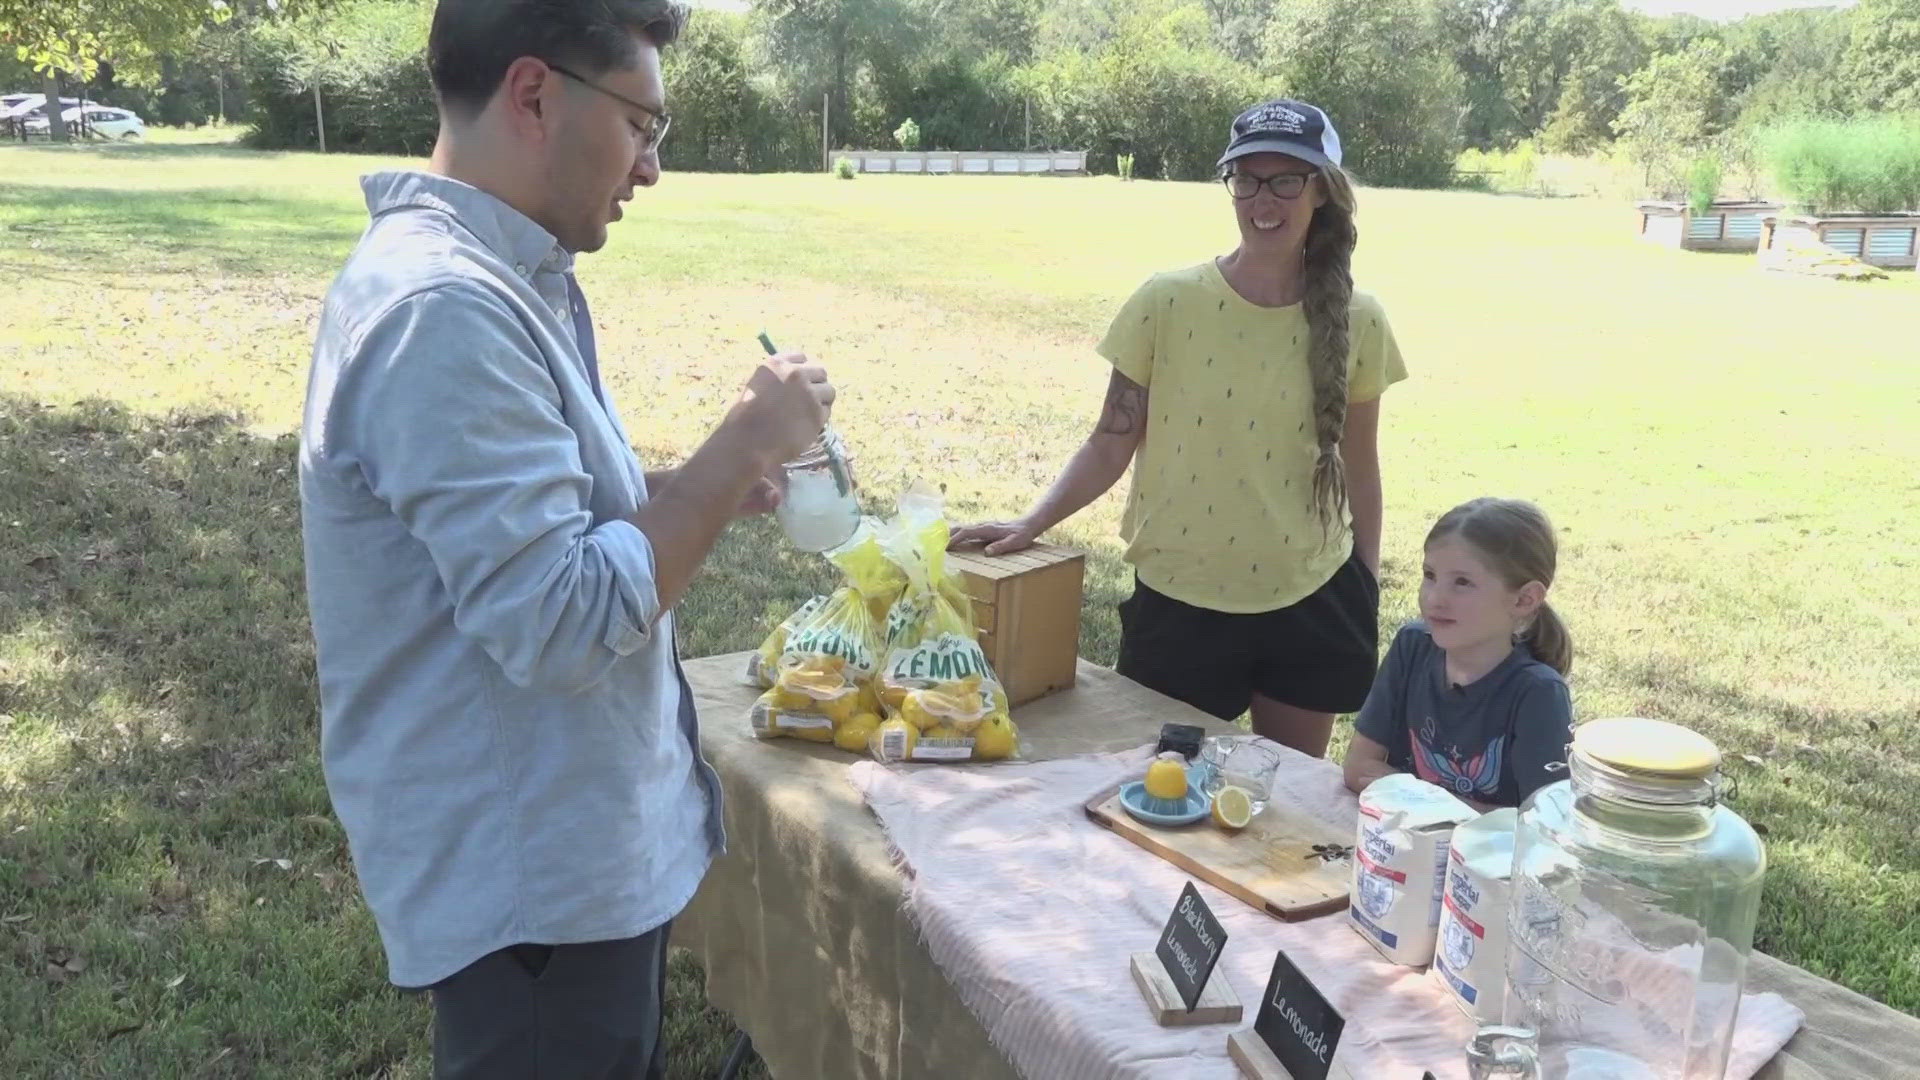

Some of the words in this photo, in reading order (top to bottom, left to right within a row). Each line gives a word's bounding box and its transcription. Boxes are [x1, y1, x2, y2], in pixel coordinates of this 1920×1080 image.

[1362, 824, 1395, 856] Imperial
[1450, 869, 1479, 905] Imperial
[1271, 979, 1328, 1064] Lemonade
